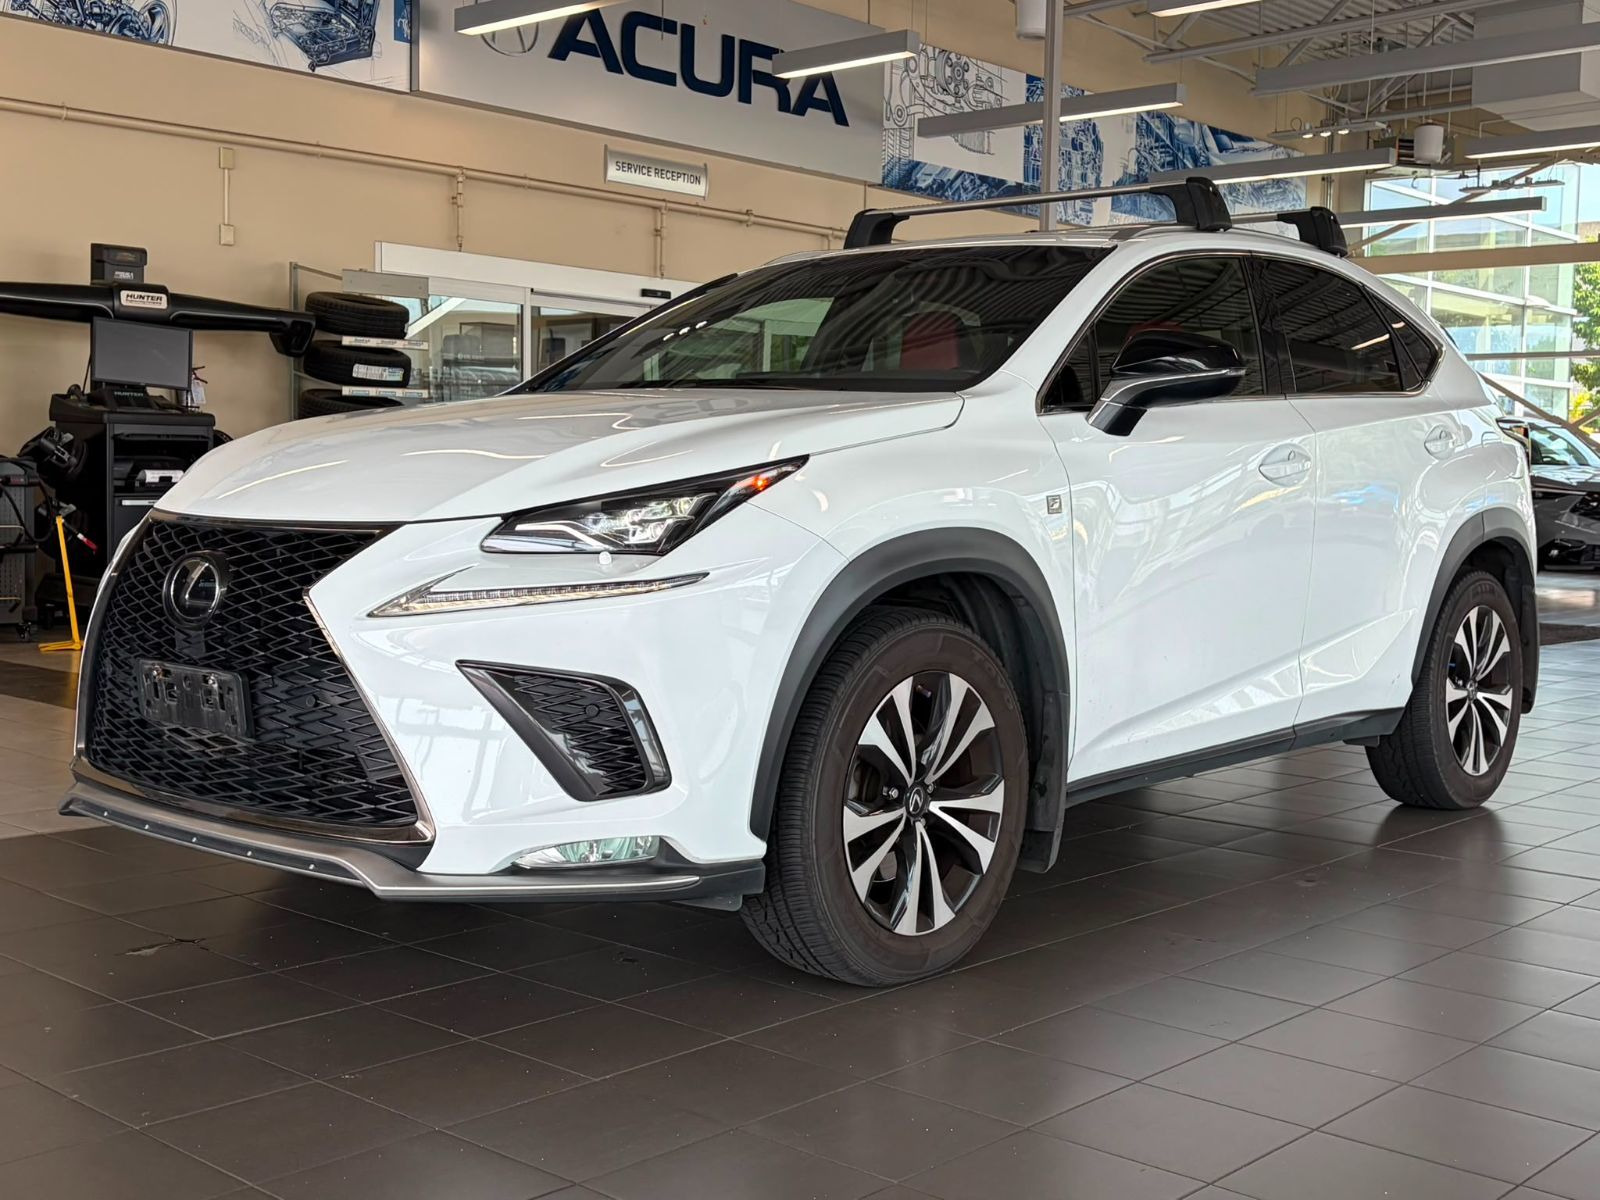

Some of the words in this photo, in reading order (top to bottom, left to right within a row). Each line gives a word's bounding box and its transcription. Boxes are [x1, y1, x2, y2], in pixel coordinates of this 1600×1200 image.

[547, 7, 850, 127] ACURA
[615, 160, 653, 177] SERVICE
[654, 167, 701, 185] RECEPTION
[125, 293, 163, 302] HUNTER
